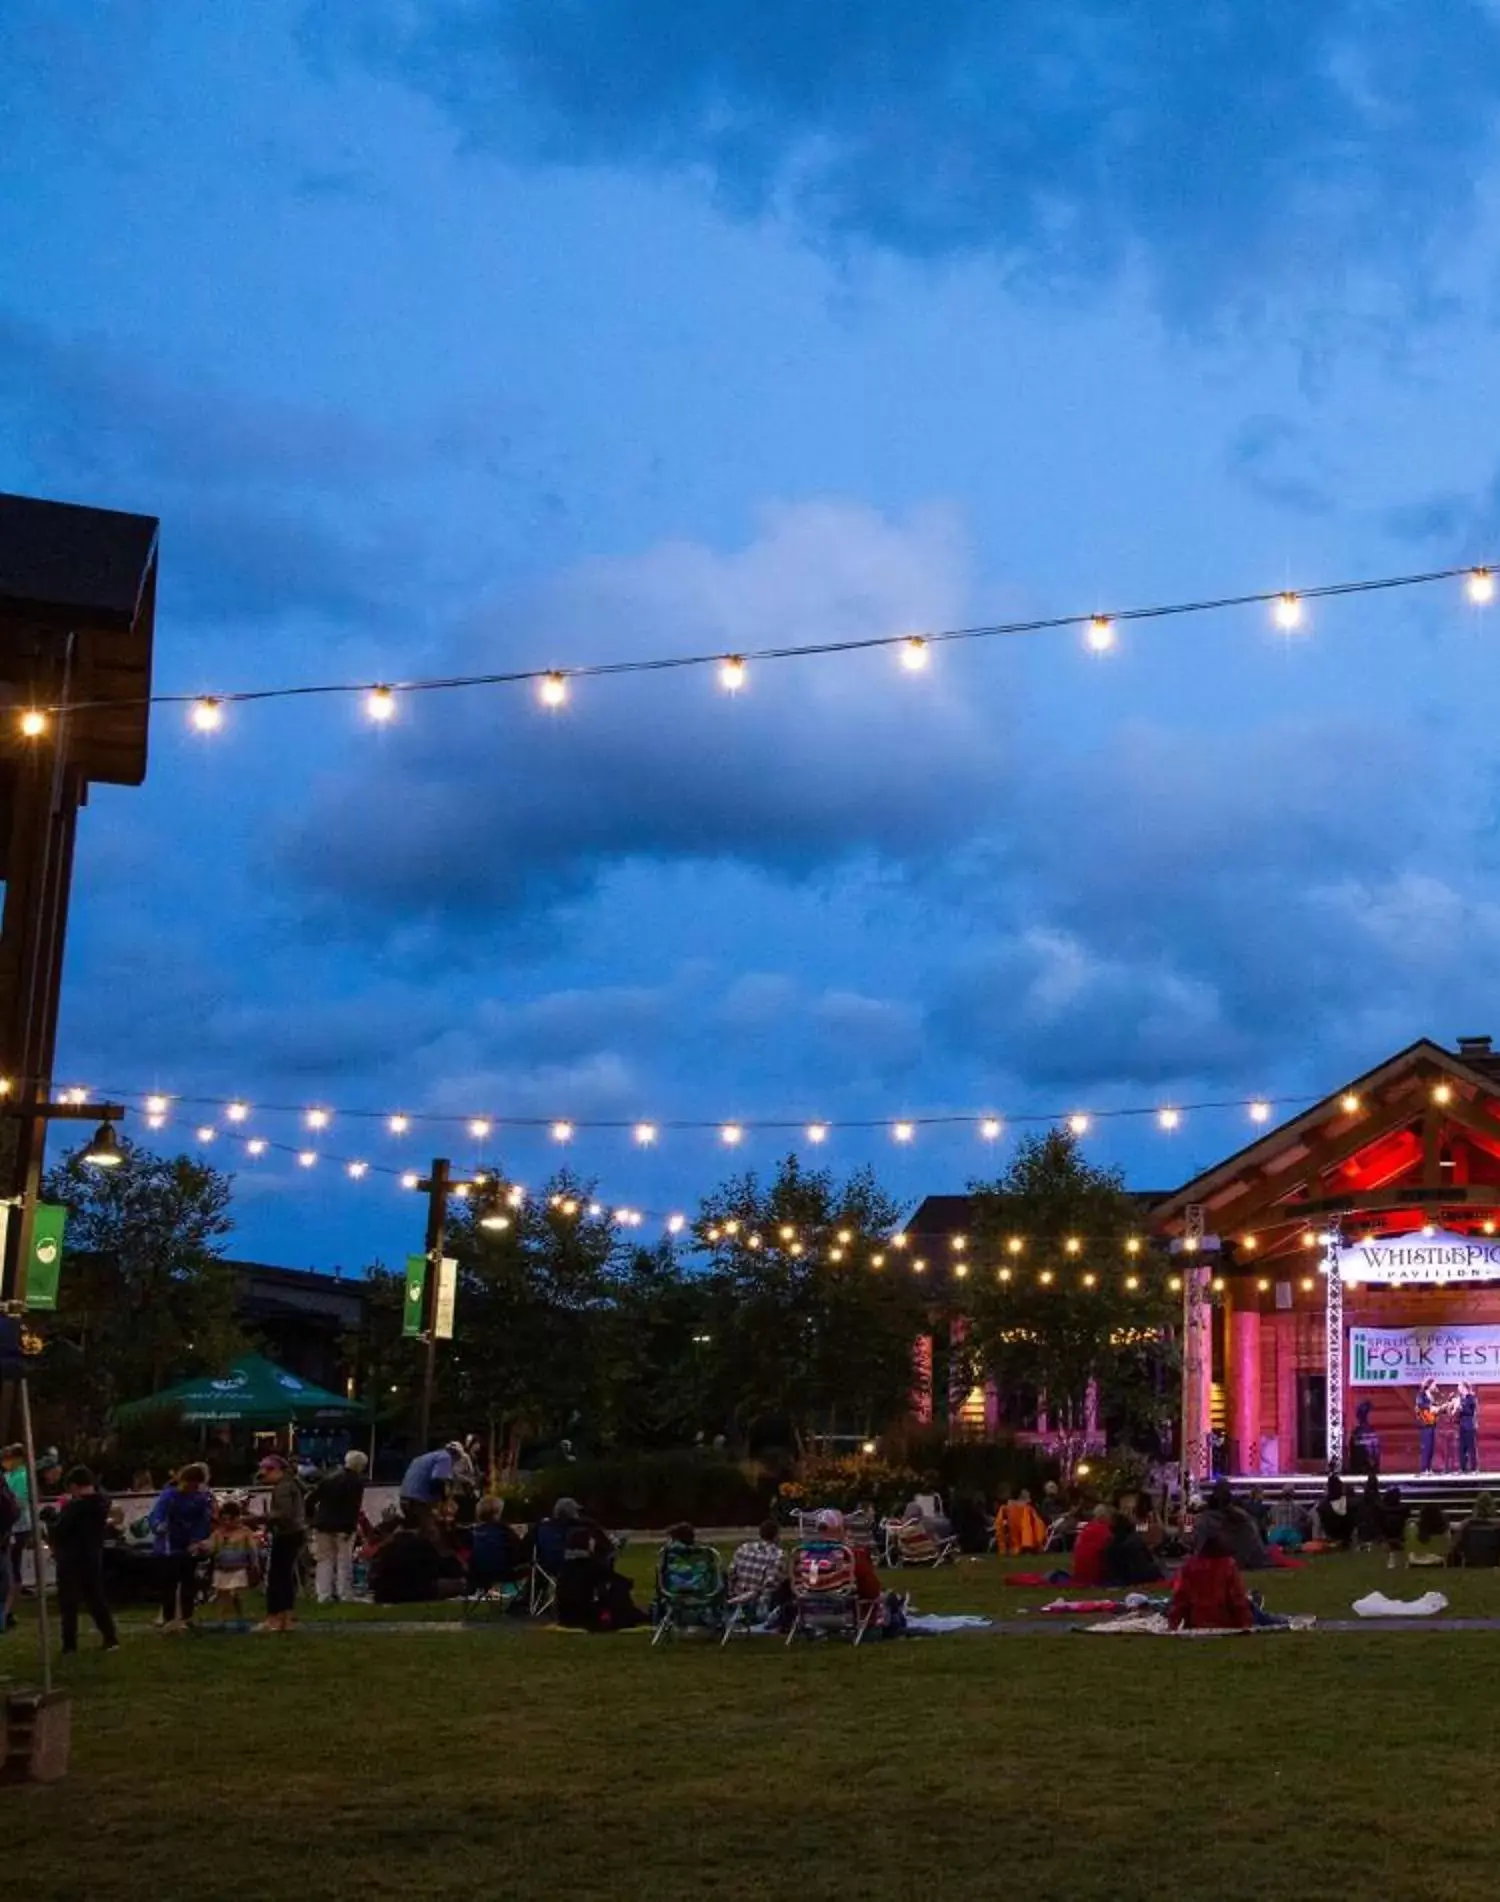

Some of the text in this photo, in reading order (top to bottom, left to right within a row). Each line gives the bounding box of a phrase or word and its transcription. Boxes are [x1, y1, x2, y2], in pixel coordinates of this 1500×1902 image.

[1387, 1268, 1480, 1278] PAVILION
[1367, 1335, 1424, 1347] SPRUCE
[1367, 1347, 1434, 1367] FOLK
